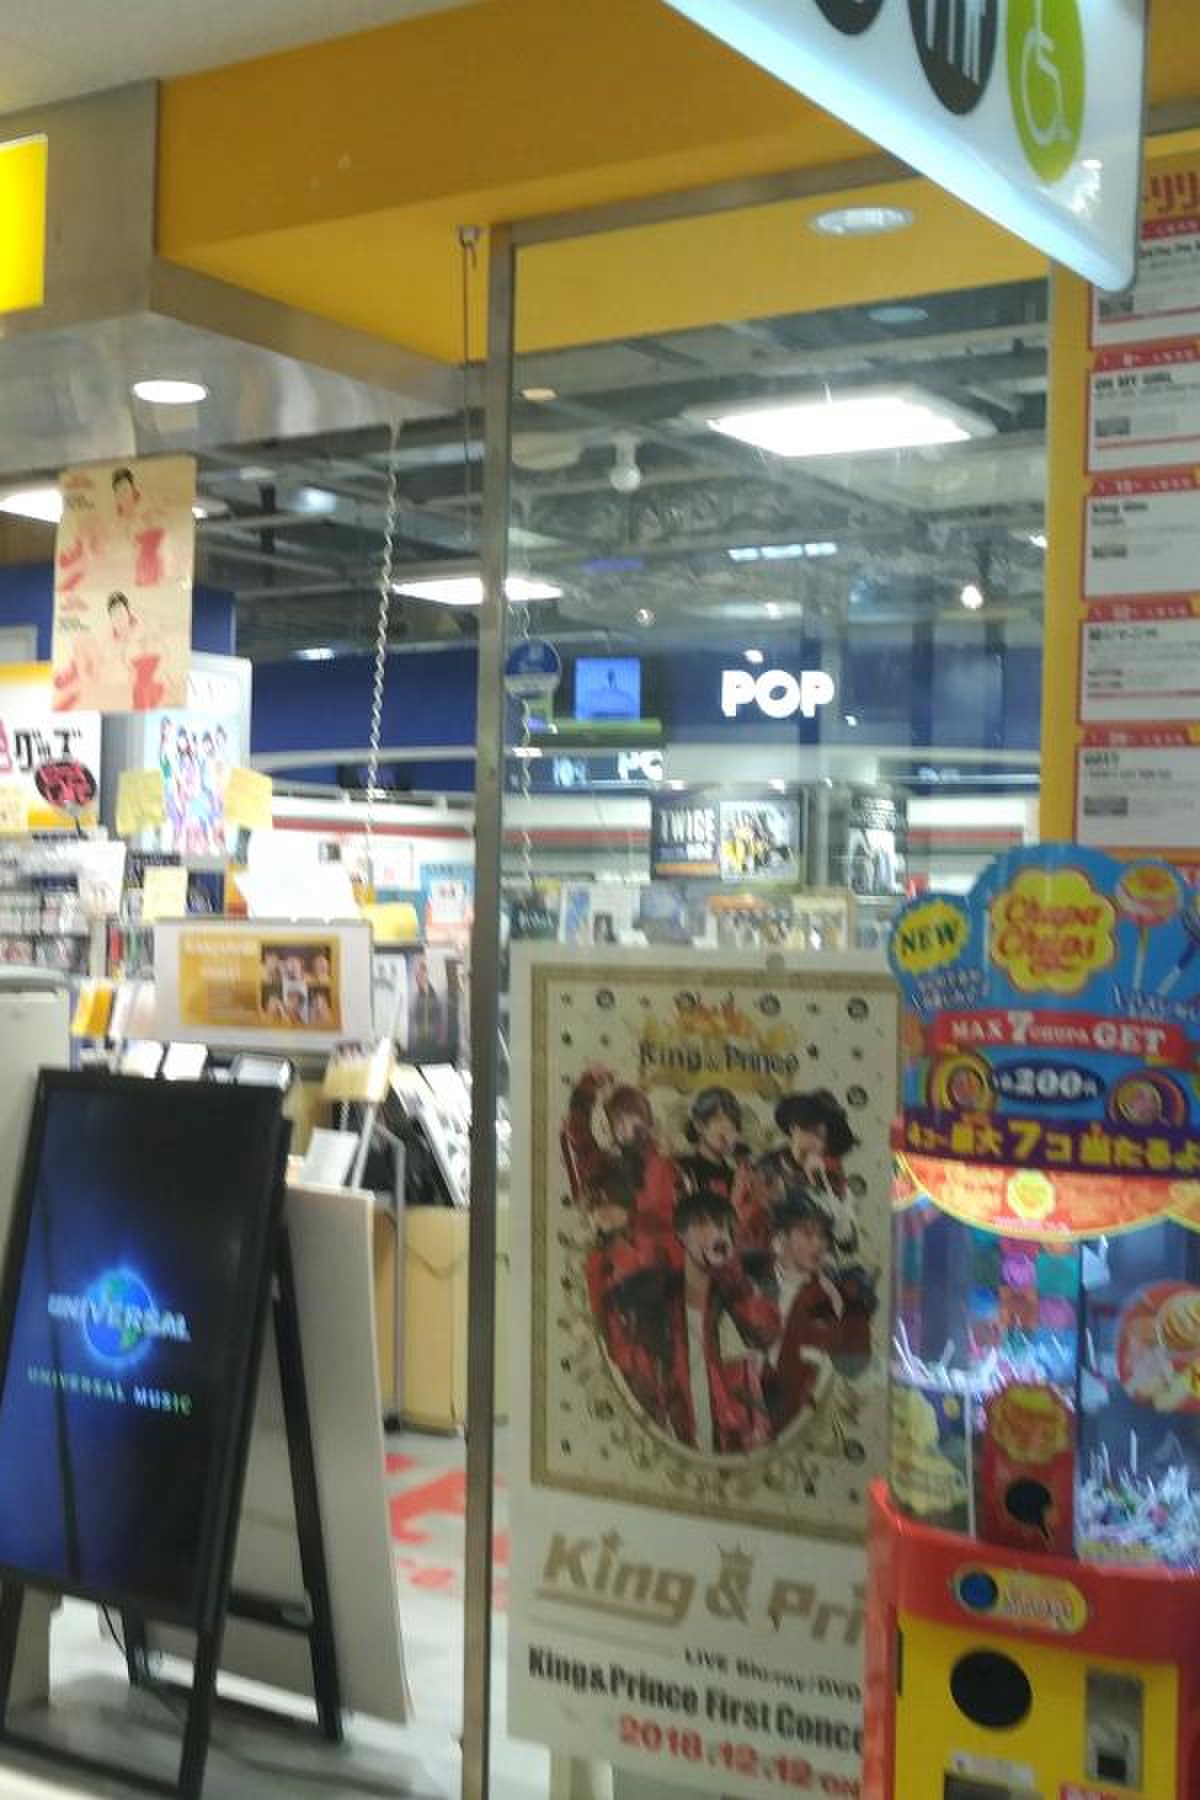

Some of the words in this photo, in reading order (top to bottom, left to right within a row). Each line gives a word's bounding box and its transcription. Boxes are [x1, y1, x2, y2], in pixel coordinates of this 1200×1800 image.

[721, 669, 836, 719] POP
[657, 808, 716, 843] TWICE
[900, 918, 961, 956] NEW
[638, 1038, 701, 1073] King
[724, 1043, 800, 1074] Prince
[951, 1019, 1002, 1041] MAX
[1092, 1022, 1167, 1056] GET
[48, 1293, 192, 1342] UNIVERSAL
[27, 1364, 126, 1402] UNIVERSAL
[133, 1385, 193, 1415] MUSIC
[538, 1527, 698, 1630] King
[683, 1647, 728, 1673] LIVE
[705, 1685, 771, 1734] First
